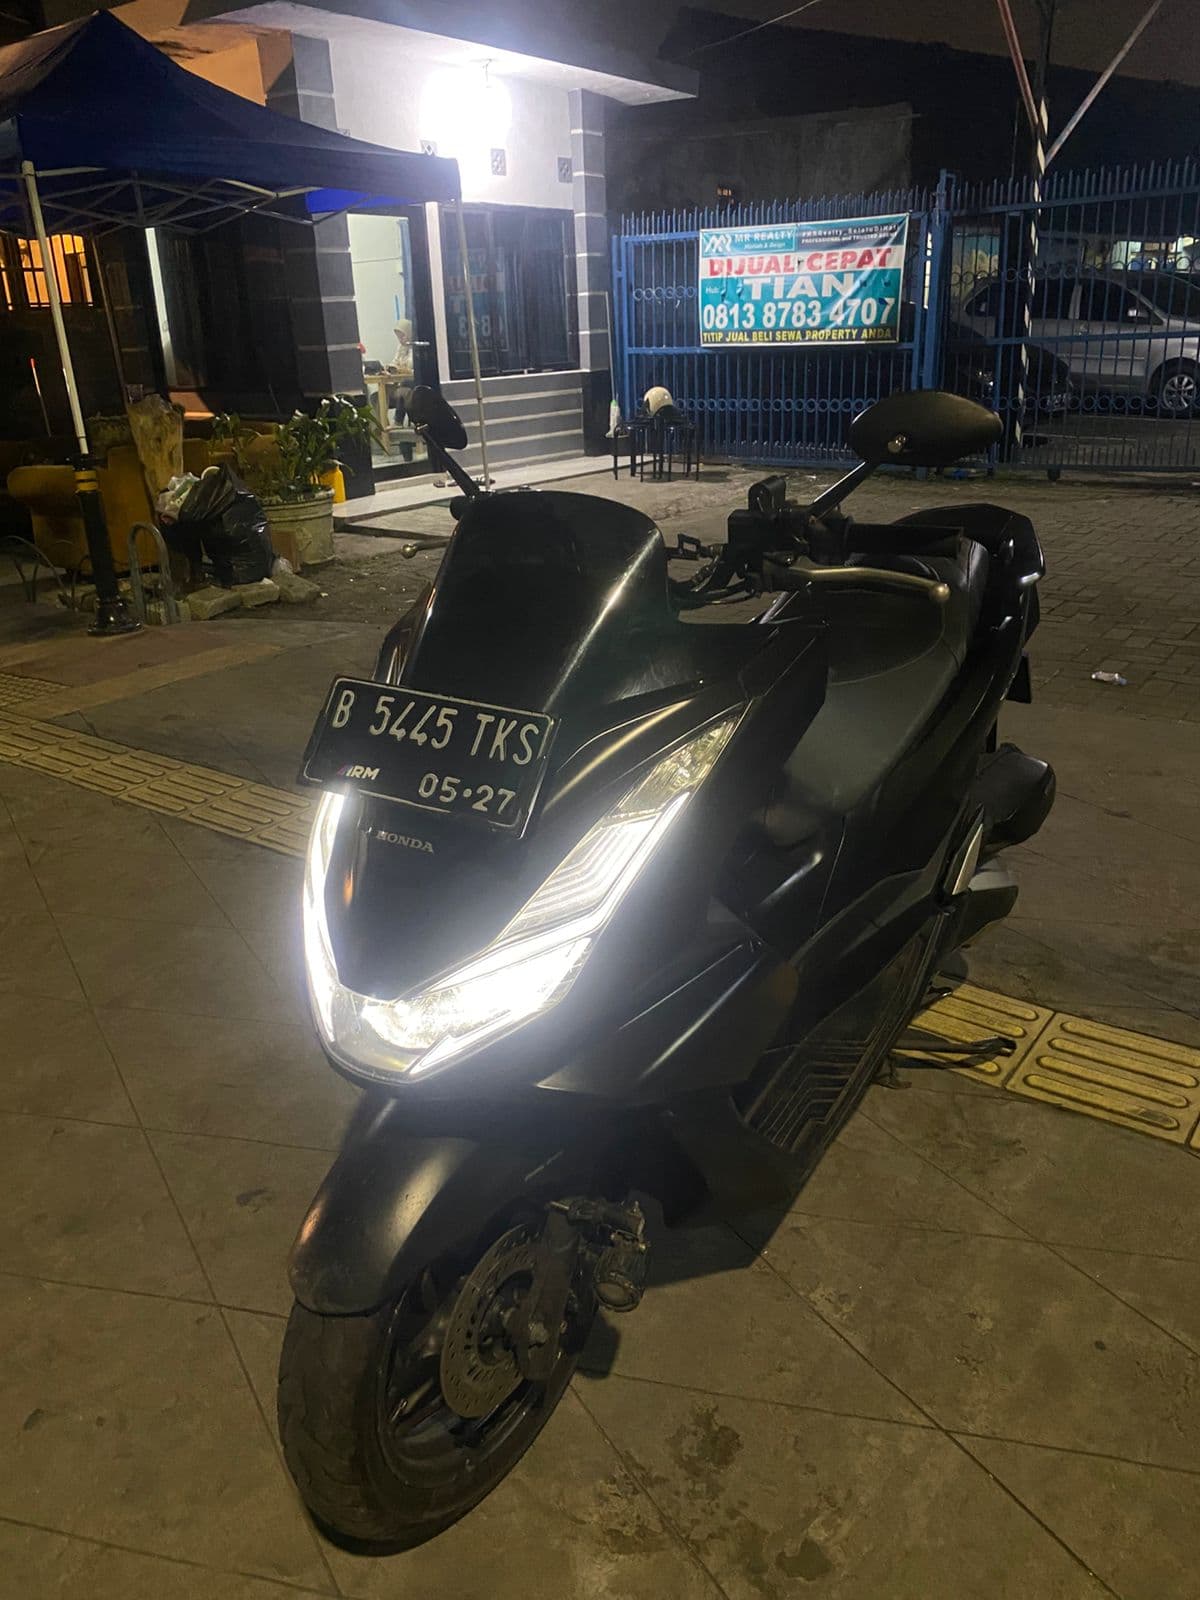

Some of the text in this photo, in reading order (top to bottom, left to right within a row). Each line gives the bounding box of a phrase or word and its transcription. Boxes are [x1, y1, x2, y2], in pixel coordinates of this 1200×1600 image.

[734, 230, 794, 243] MR REALTY
[709, 248, 892, 277] DIJUAL CEPAT
[743, 273, 855, 300] TIAN
[703, 297, 896, 330] 0813 8783 4707
[703, 327, 892, 342] TITIP JUAL BELI SEWA PROPERTY ANDA
[332, 689, 541, 766] B 5445 TKS
[375, 830, 434, 853] HONDA
